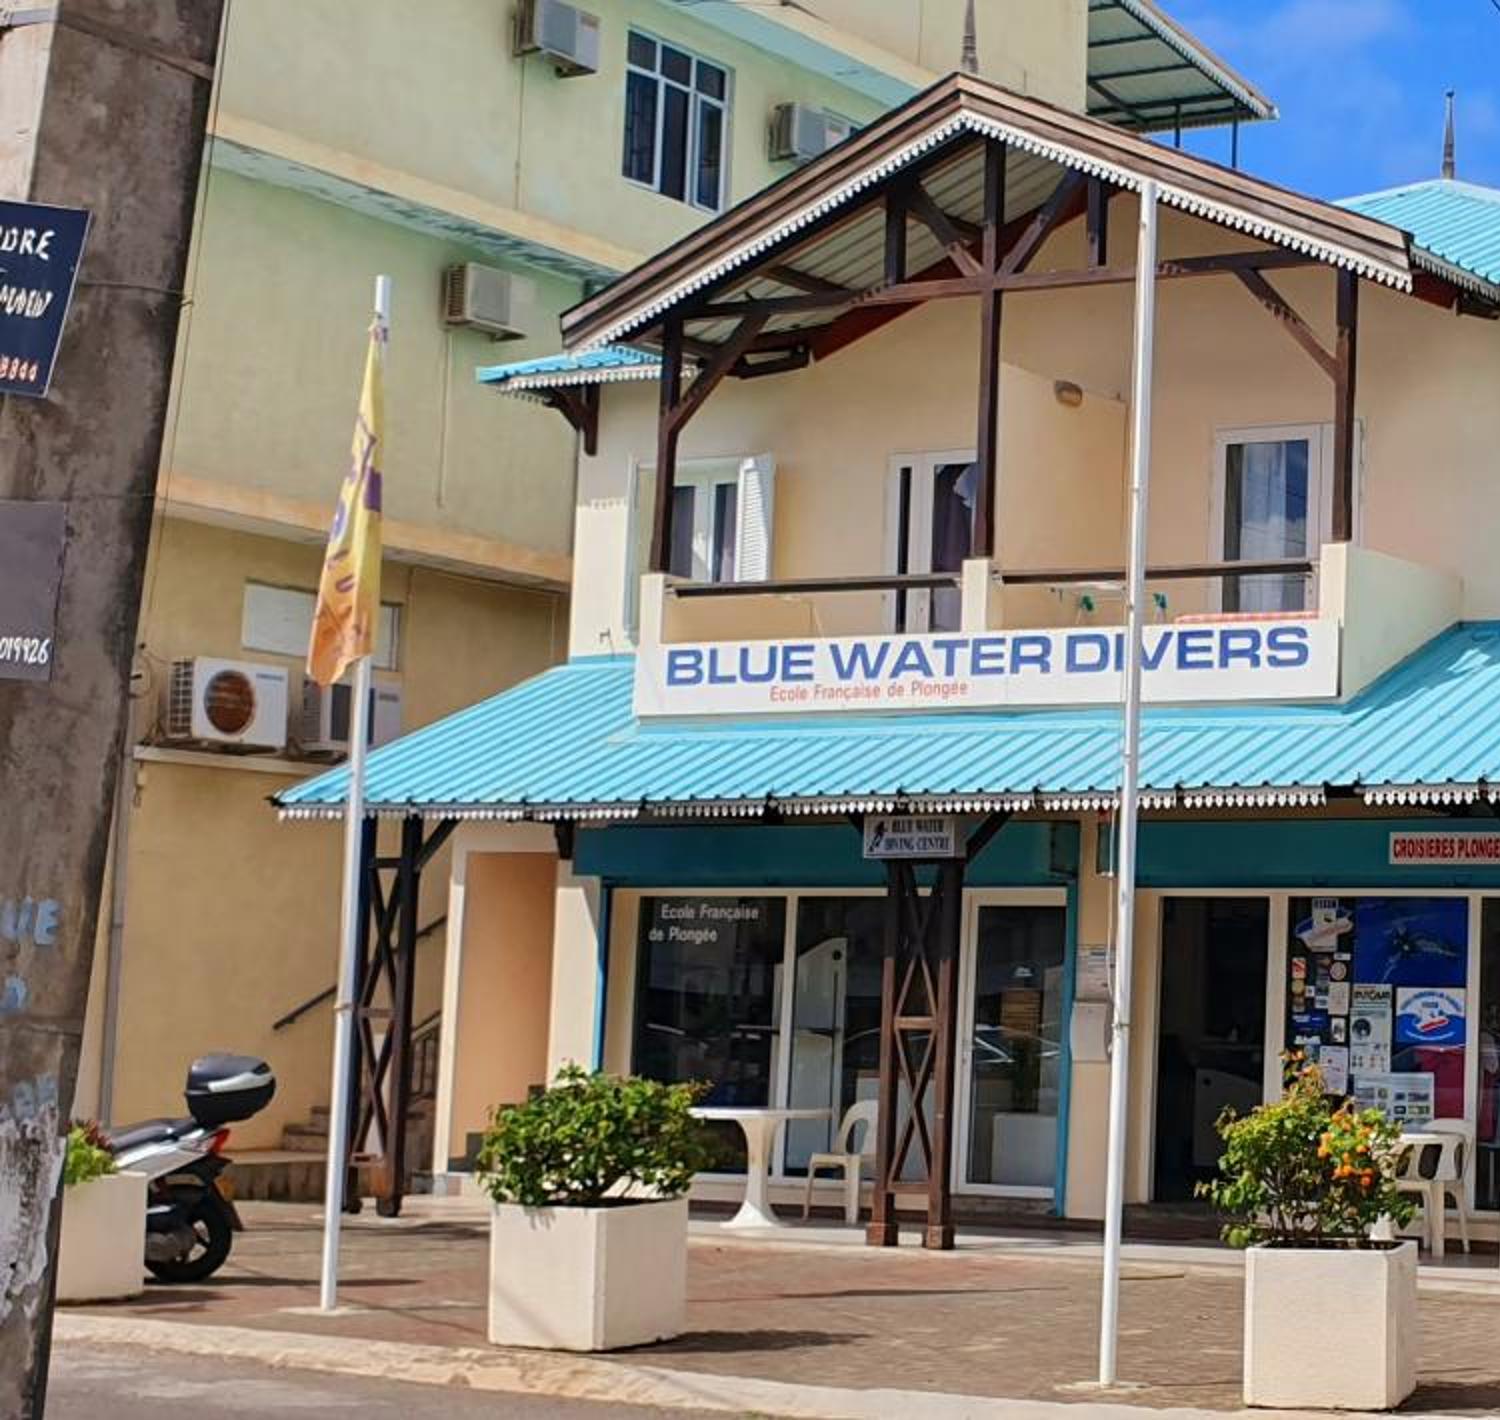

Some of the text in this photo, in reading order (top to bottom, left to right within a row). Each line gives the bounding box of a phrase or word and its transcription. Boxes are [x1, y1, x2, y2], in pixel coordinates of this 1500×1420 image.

[0, 226, 55, 261] DRE
[667, 626, 1309, 686] BLUE WATER DIVERS
[769, 684, 808, 702] Ecole
[814, 681, 880, 701] Française
[887, 681, 904, 697] de
[1393, 837, 1455, 859] CROISIERES
[660, 903, 759, 922] Ecole Française
[648, 927, 665, 941] de
